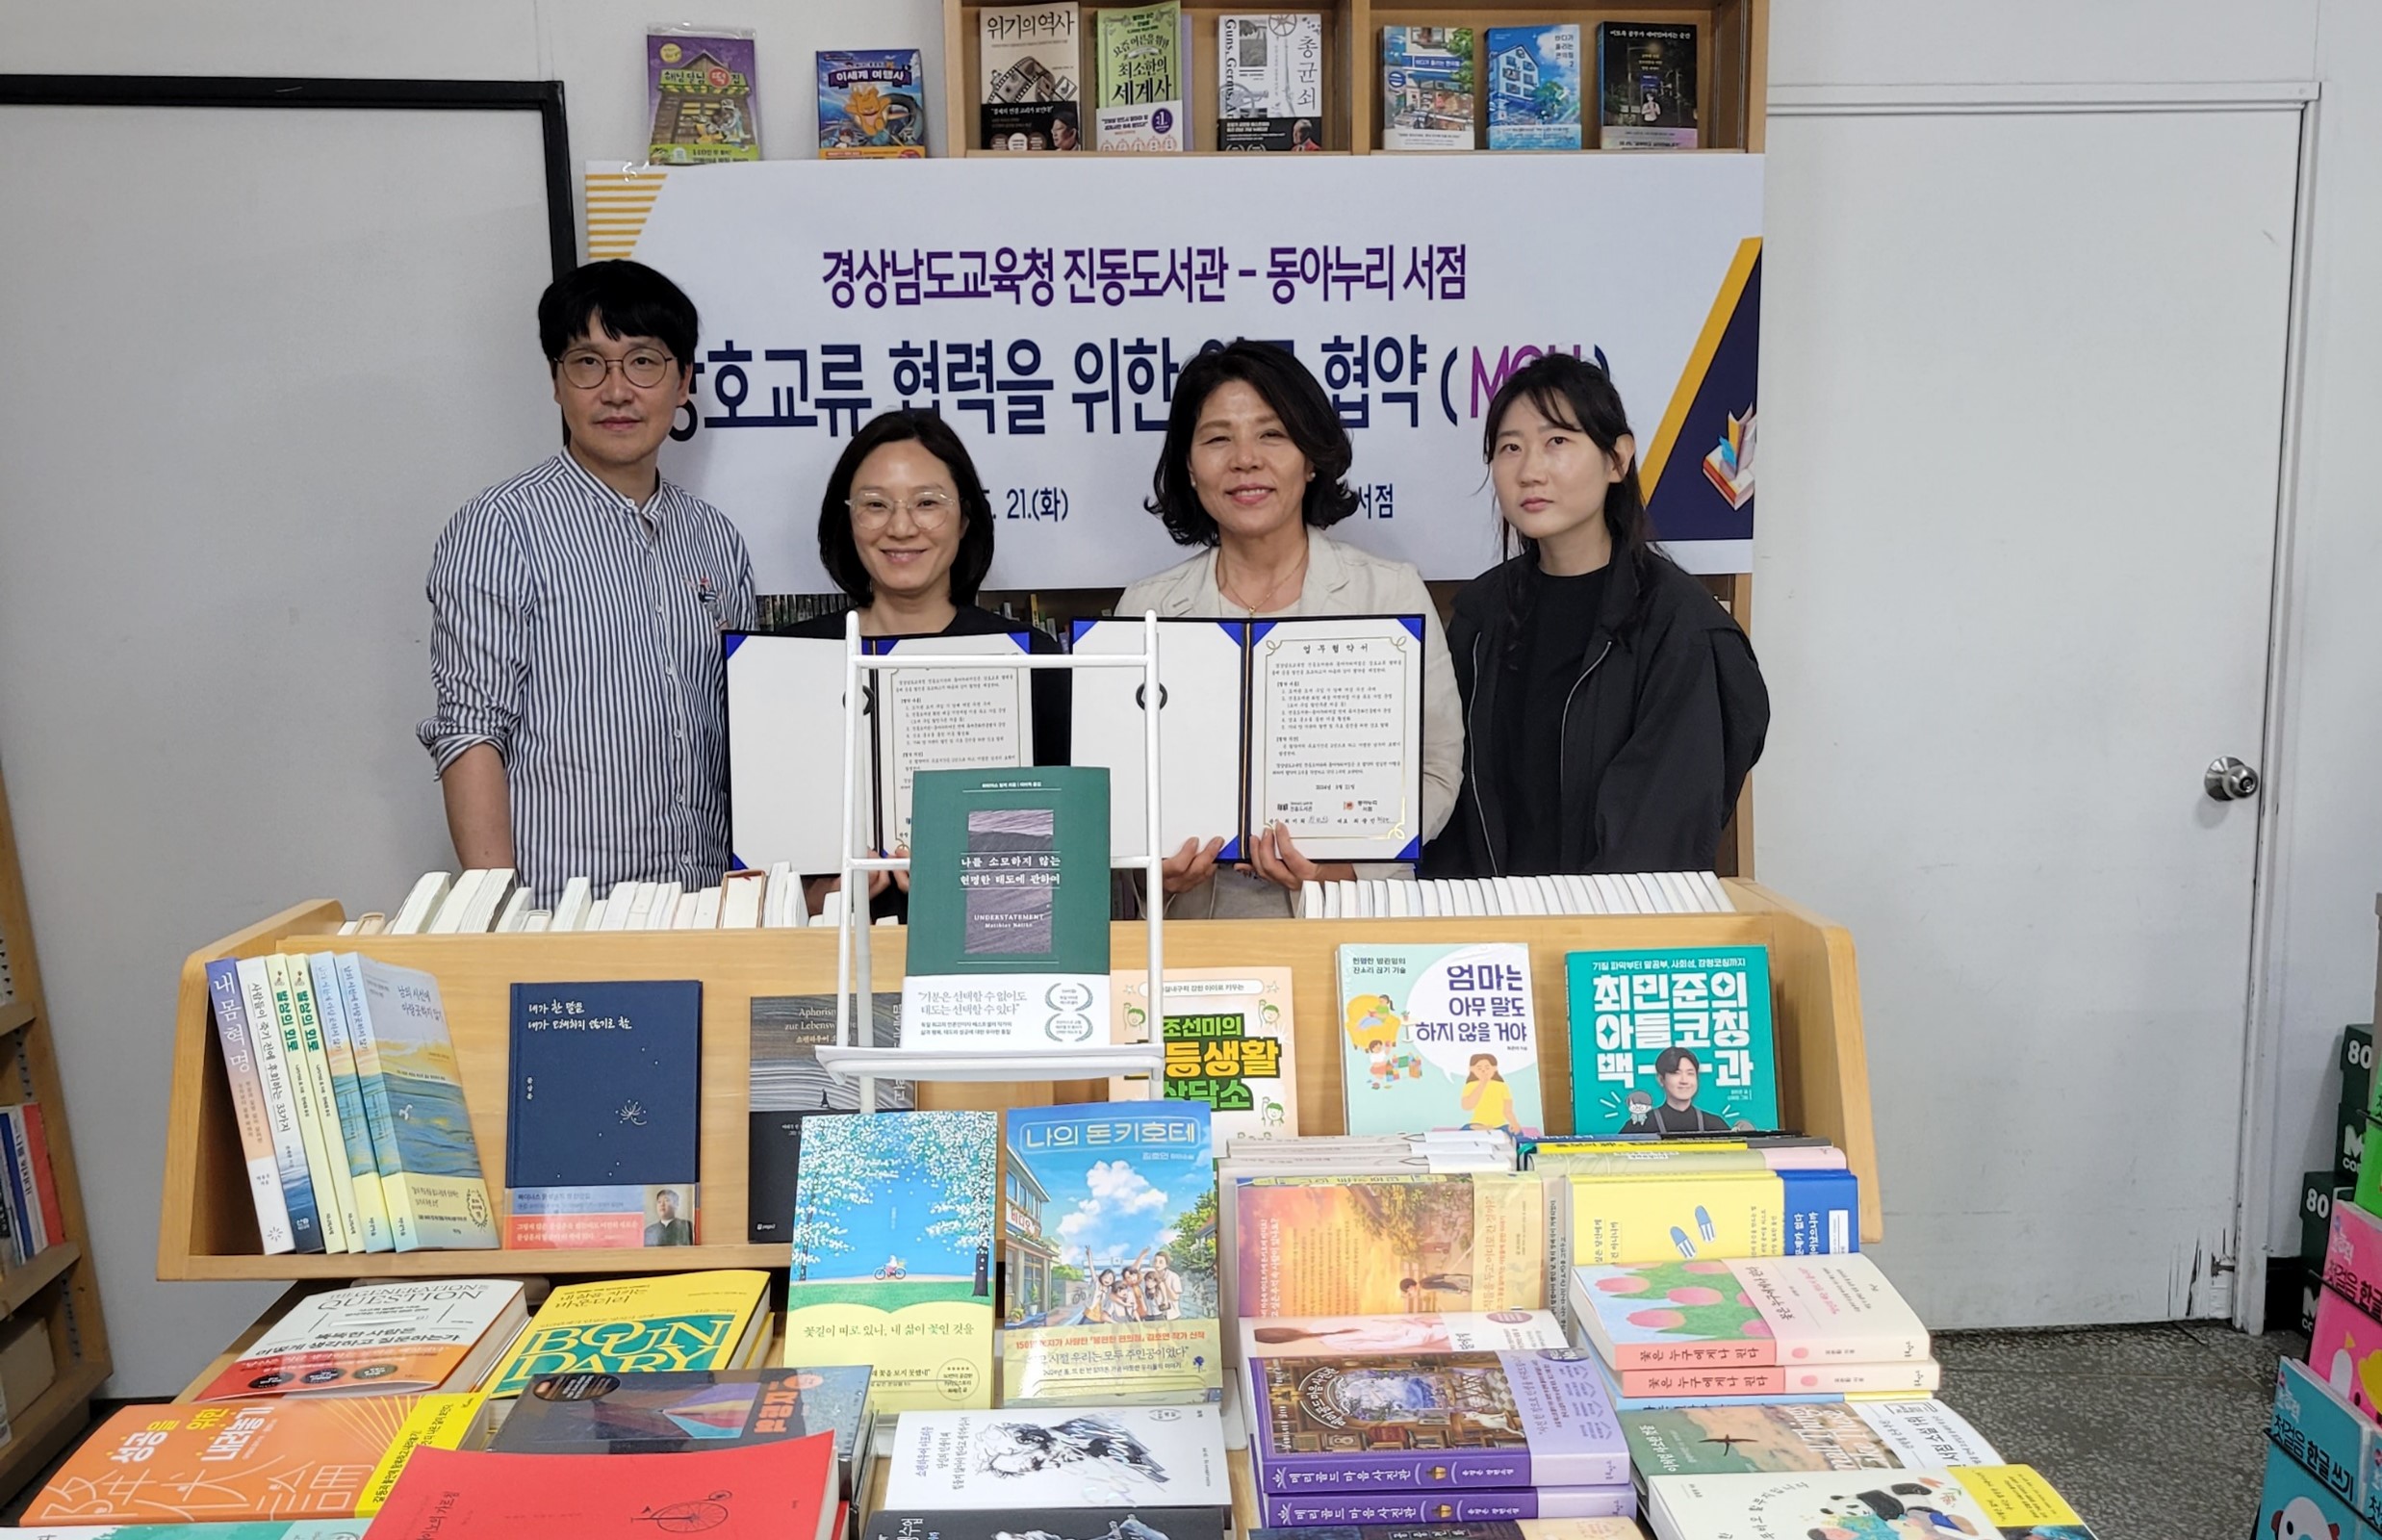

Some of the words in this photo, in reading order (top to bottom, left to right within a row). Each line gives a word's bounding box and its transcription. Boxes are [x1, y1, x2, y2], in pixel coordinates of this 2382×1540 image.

[987, 14, 1037, 39] 위기의
[1038, 11, 1074, 37] 역사
[1225, 18, 1237, 55] Guns,
[1118, 57, 1167, 79] 최소한의
[1225, 57, 1237, 103] Germs,
[1112, 76, 1172, 105] 세계사
[823, 246, 1055, 309] 경상남도교육청
[1063, 244, 1229, 306] 진동도서관
[1266, 244, 1396, 304] 동아누리
[1403, 244, 1467, 300] 서점
[889, 338, 1055, 436] 협력을
[1071, 336, 1179, 435] 위한
[1321, 334, 1428, 429] 협약
[1007, 486, 1069, 523] 21.(화)
[960, 856, 983, 867] 나를
[988, 856, 1033, 867] 소모하지
[1038, 856, 1061, 867] 않는
[960, 874, 991, 886] 현명한
[995, 874, 1025, 885] 태도에
[1030, 873, 1061, 885] 관하여
[214, 972, 237, 995] 내
[1447, 964, 1524, 991] 엄마는
[251, 983, 268, 1019] 사람들이
[953, 991, 983, 1003] 선택할
[985, 991, 995, 1002] 수
[996, 990, 1027, 1002] 없어도
[1593, 971, 1748, 1012] 최민준의
[218, 999, 242, 1021] 몸
[276, 991, 294, 1026] 발상의
[296, 990, 314, 1026] 발상의
[551, 999, 562, 1014] 한
[921, 1004, 951, 1015] 태도는
[953, 1004, 983, 1015] 선택할
[985, 1004, 995, 1015] 수
[1448, 997, 1486, 1016] 아무
[1491, 996, 1525, 1016] 말도
[259, 1020, 272, 1040] 죽기
[552, 1018, 585, 1031] 오해하지
[588, 1017, 616, 1030] 않기로
[618, 1015, 632, 1030] 함
[784, 1022, 799, 1031] zur
[1163, 1015, 1242, 1038] 조선미의
[1416, 1022, 1454, 1042] 하지
[1458, 1022, 1491, 1042] 않을
[1494, 1022, 1527, 1042] 거야
[1595, 1010, 1751, 1050] 아들코칭
[224, 1024, 250, 1073] 혁명
[263, 1041, 276, 1062] 전에
[283, 1027, 299, 1053] 회로
[303, 1027, 320, 1053] 회로
[1165, 1040, 1279, 1078] 등생활
[2348, 1040, 2372, 1069] 80
[267, 1064, 285, 1103] 후회하는
[1026, 1127, 1079, 1148] 나의
[1086, 1122, 1195, 1145] 돈키호테
[2306, 1188, 2329, 1219] 80
[1594, 1219, 1602, 1247] 당신에게
[1794, 1213, 1805, 1230] 없다
[1610, 1222, 1619, 1250] 아니니까
[2324, 1259, 2359, 1301] 첫걸음
[318, 1291, 483, 1310] QUESTION
[804, 1324, 835, 1338] 꽃길이
[838, 1324, 861, 1338] 따로
[890, 1323, 901, 1337] 내
[905, 1322, 925, 1336] 삶이
[928, 1323, 950, 1336] 꽃인
[955, 1322, 974, 1335] 것을
[1071, 1352, 1102, 1363] 우리는
[1103, 1349, 1124, 1361] 모두
[1640, 1350, 1666, 1363] 꽃은
[1670, 1348, 1729, 1361] 누구에게나
[1737, 1346, 1760, 1359] 핀다
[1649, 1376, 1674, 1390] 꽃은
[1678, 1375, 1738, 1389] 누구에게나
[1746, 1374, 1769, 1388] 핀다
[111, 1420, 180, 1462] 성공을
[187, 1407, 229, 1431] 위한
[200, 1405, 274, 1461] 내려놓기
[1639, 1424, 1661, 1437] 것들
[1785, 1406, 1829, 1441] Things
[1824, 1409, 1876, 1443] These
[1647, 1435, 1668, 1453] 사소한
[1659, 1452, 1678, 1472] 이처럼
[2274, 1412, 2306, 1460] 첫걸음
[2306, 1439, 2331, 1484] 한글
[2331, 1462, 2354, 1503] 쓰기
[1289, 1472, 1341, 1484] 메리골드
[1346, 1471, 1370, 1483] 마음
[1372, 1469, 1412, 1482] 사진관
[1294, 1507, 1346, 1520] 메리골드
[1350, 1506, 1375, 1519] 마음
[1378, 1505, 1416, 1519] 사진관
